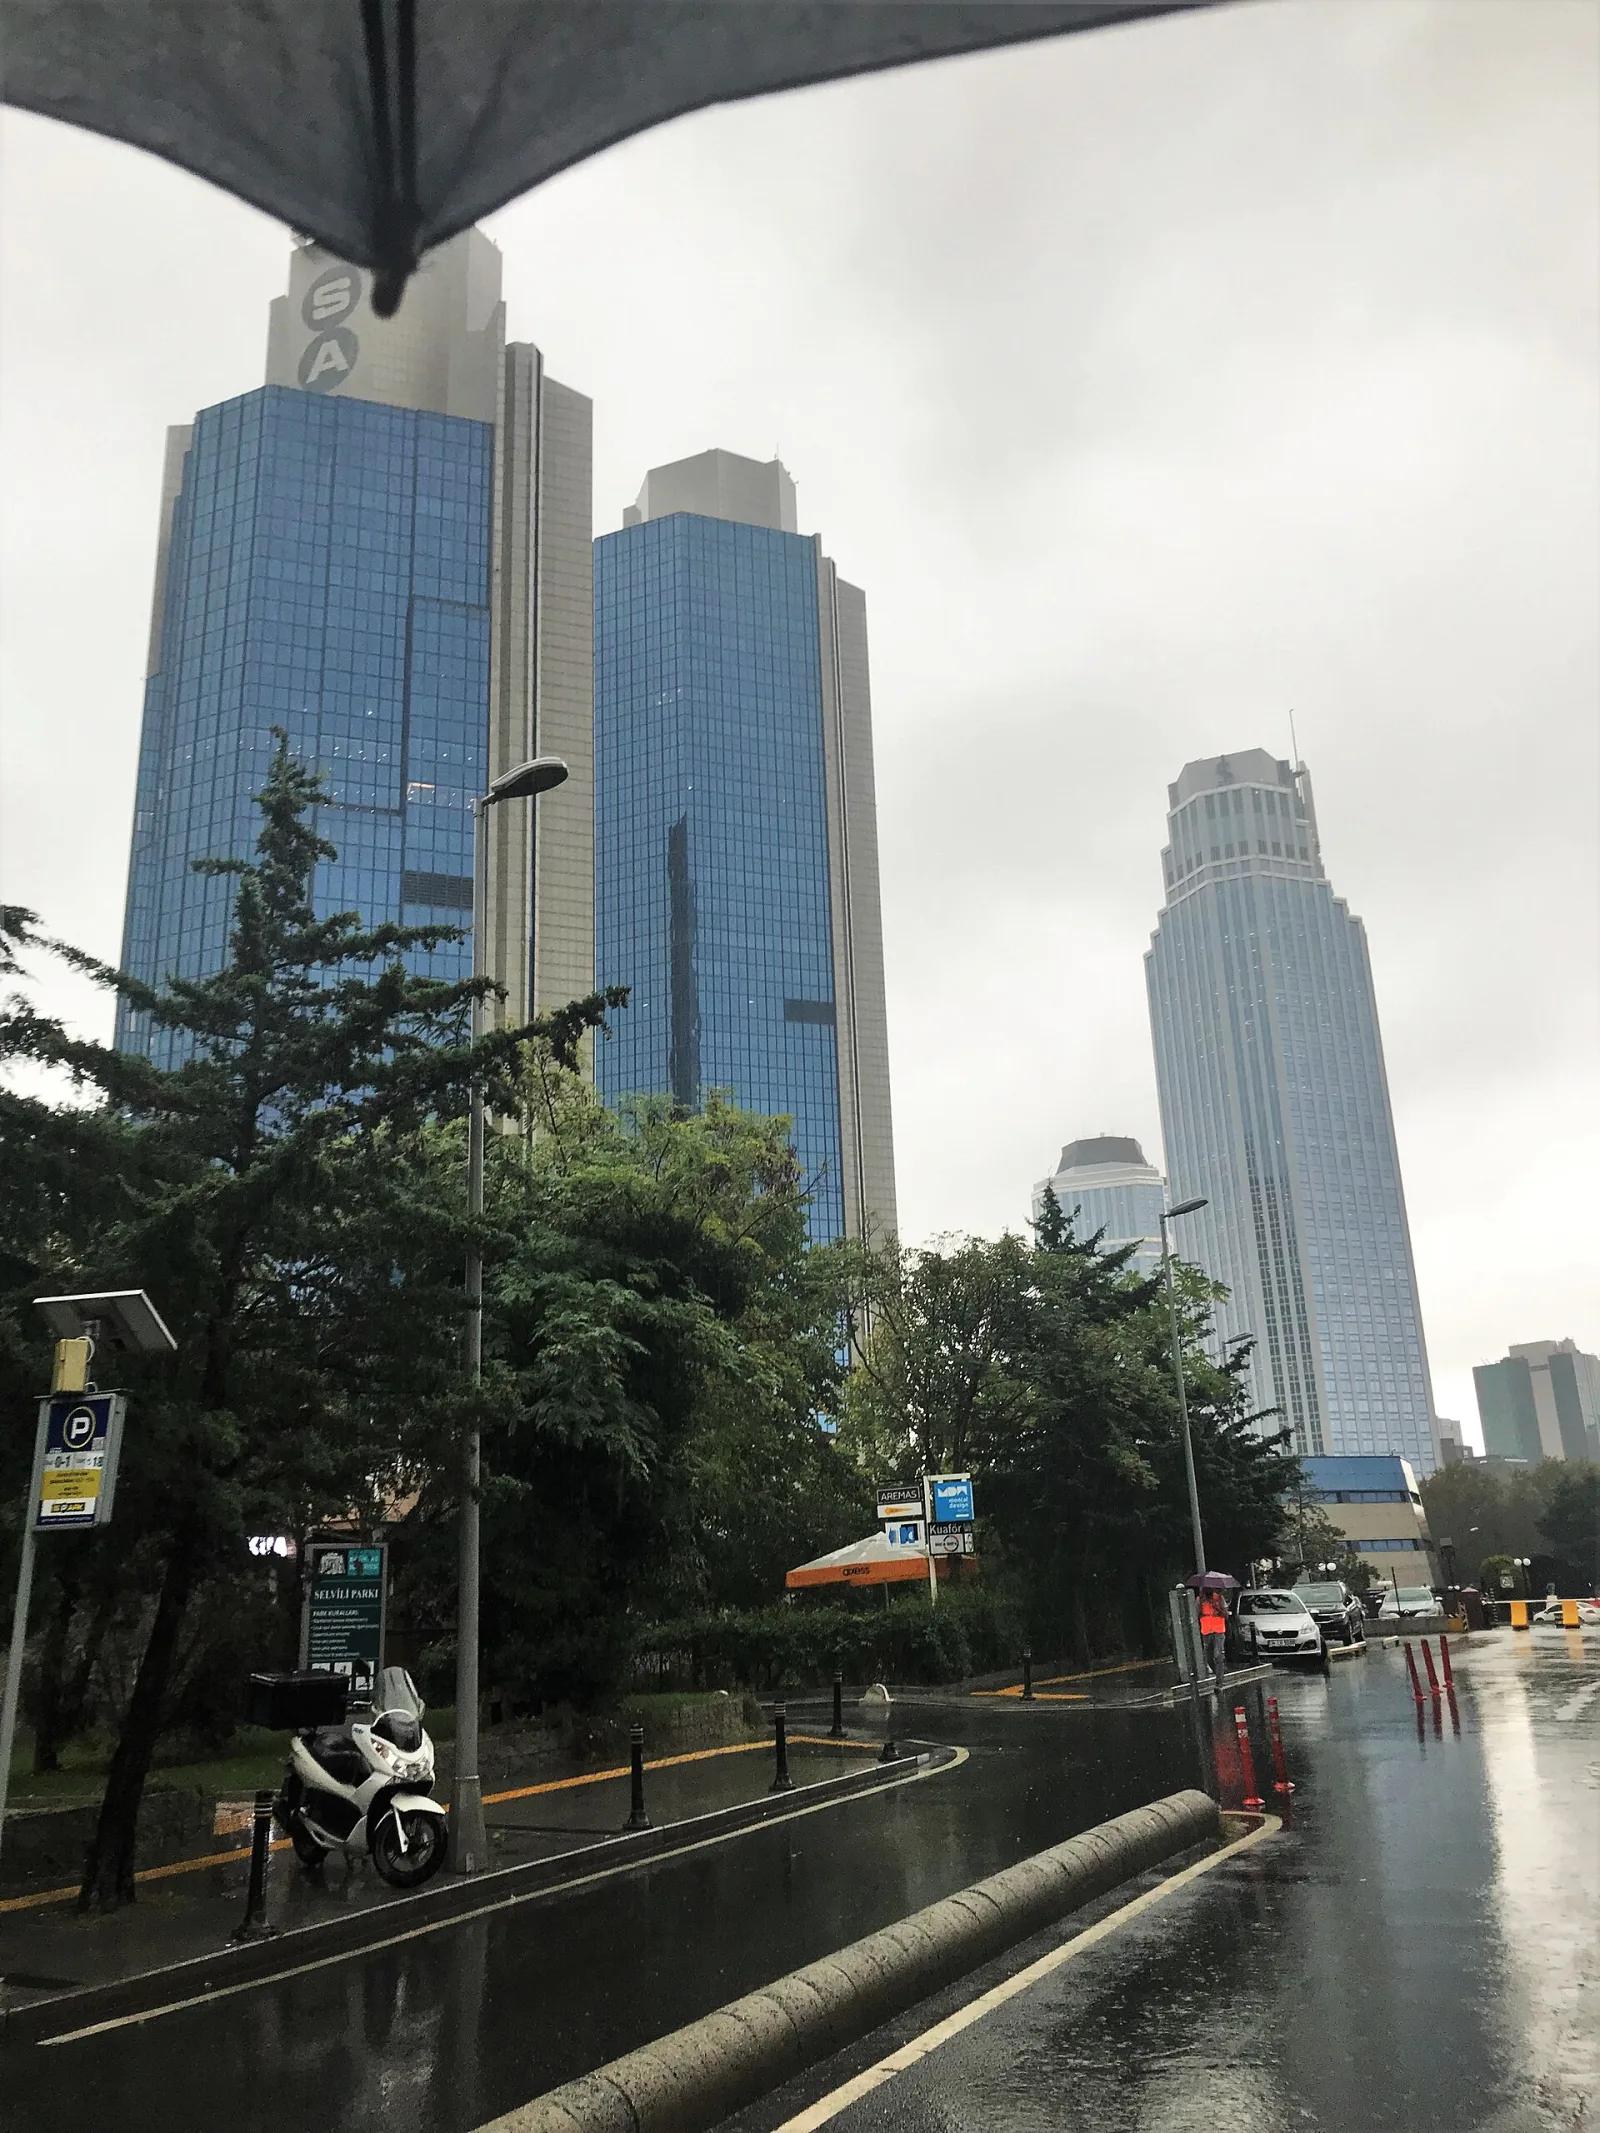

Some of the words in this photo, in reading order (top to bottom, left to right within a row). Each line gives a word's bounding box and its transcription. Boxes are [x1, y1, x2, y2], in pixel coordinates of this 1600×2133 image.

[70, 1416, 90, 1440] P
[880, 1489, 917, 1501] AREMAS
[929, 1523, 962, 1535] Kuaför
[351, 1588, 379, 1599] PARKI
